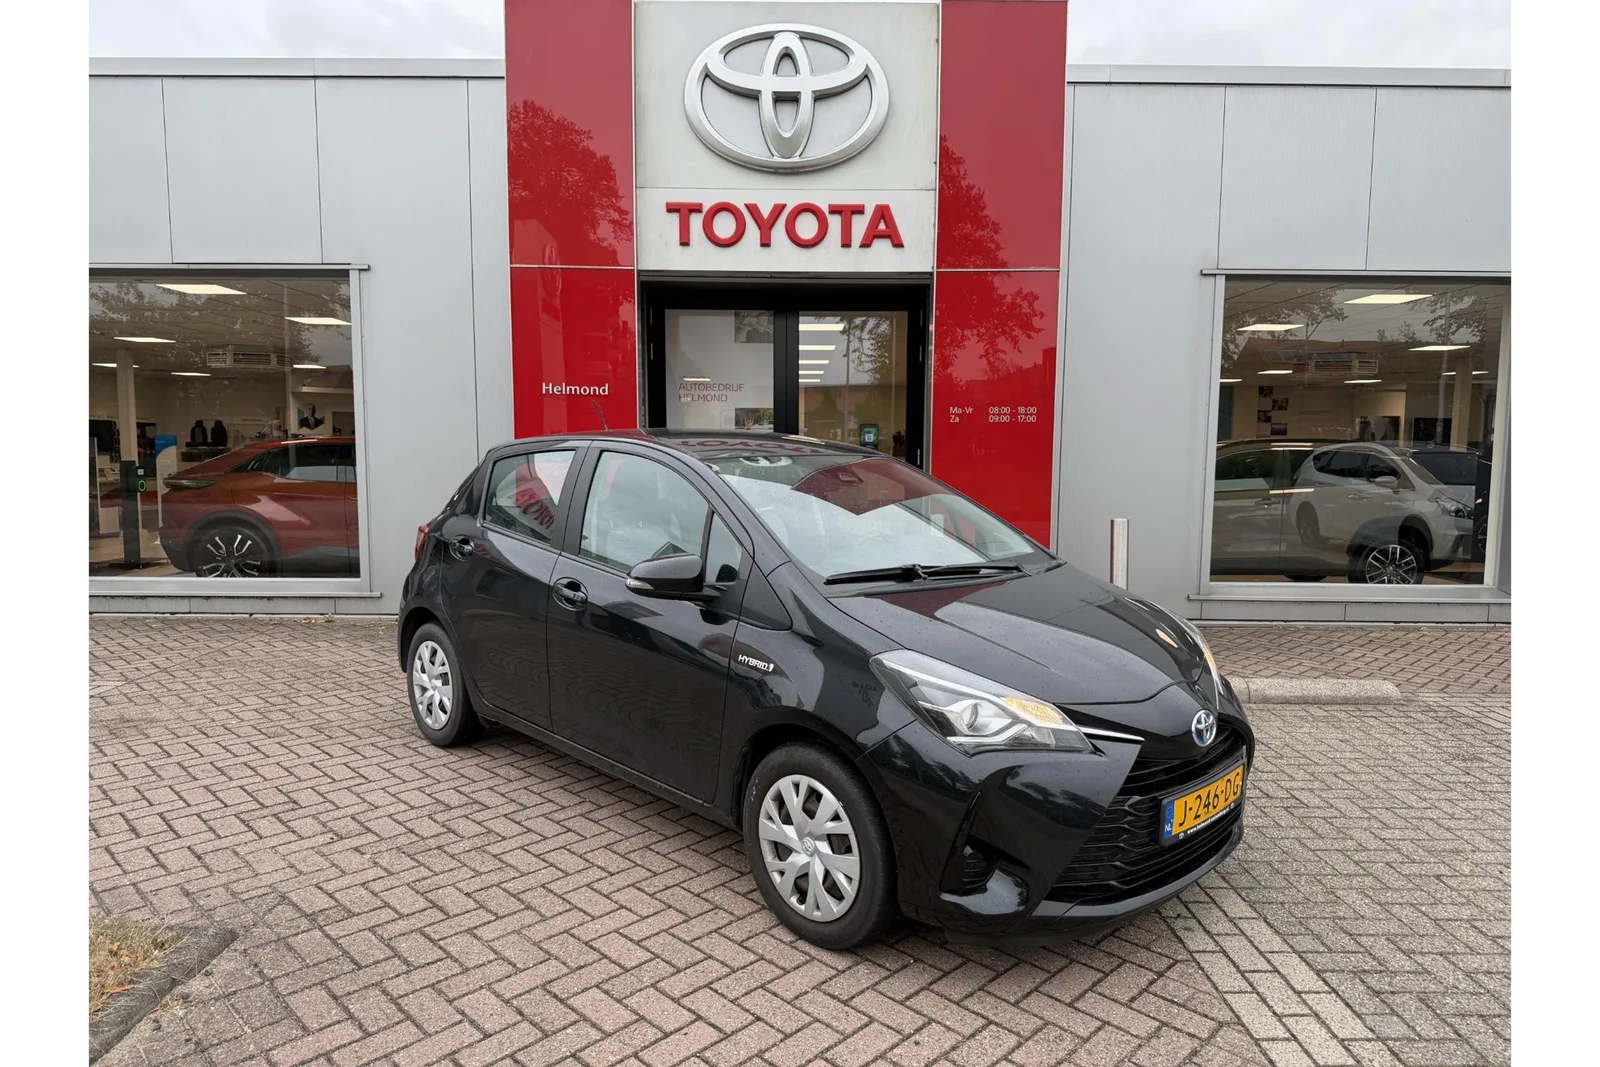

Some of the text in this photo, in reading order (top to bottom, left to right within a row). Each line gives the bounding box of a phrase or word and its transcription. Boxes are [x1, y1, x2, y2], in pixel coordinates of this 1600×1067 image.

[666, 202, 904, 248] TOYOTA
[542, 382, 609, 396] Helmond
[678, 382, 745, 392] AUTOBEDRIJF
[678, 393, 728, 402] HELMOND
[988, 406, 1011, 414] 08:00
[1017, 406, 1037, 414] 18:00
[949, 415, 960, 423] Za
[988, 415, 1010, 423] 09:00
[1017, 415, 1037, 423] 17:00
[738, 654, 768, 671] HYBRID
[1178, 772, 1240, 827] J-246-DG
[1164, 823, 1172, 832] NL
